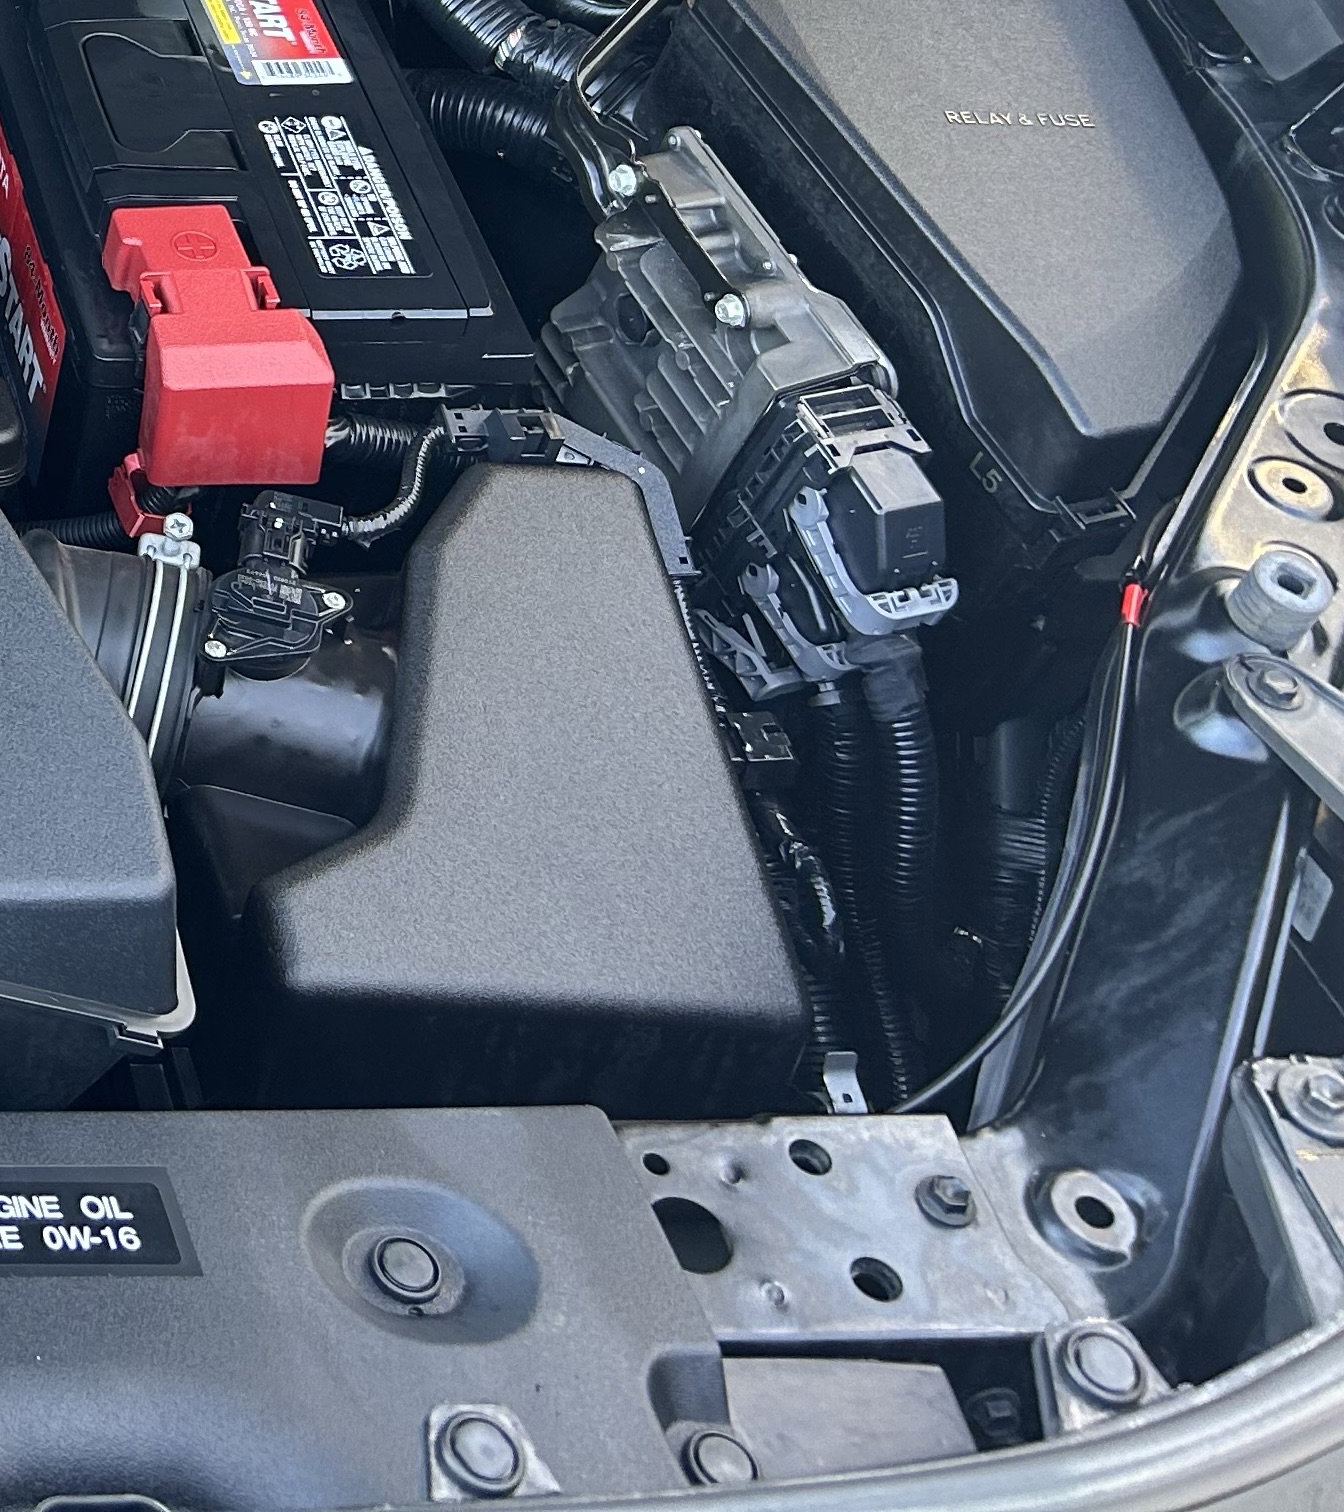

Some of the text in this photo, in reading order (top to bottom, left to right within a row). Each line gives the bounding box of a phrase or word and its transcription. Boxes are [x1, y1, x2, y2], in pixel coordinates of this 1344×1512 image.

[944, 110, 1097, 129] RELAY & FUSE
[969, 450, 1004, 494] L5
[80, 1195, 134, 1220] OIL
[42, 1225, 142, 1252] 0W-16
